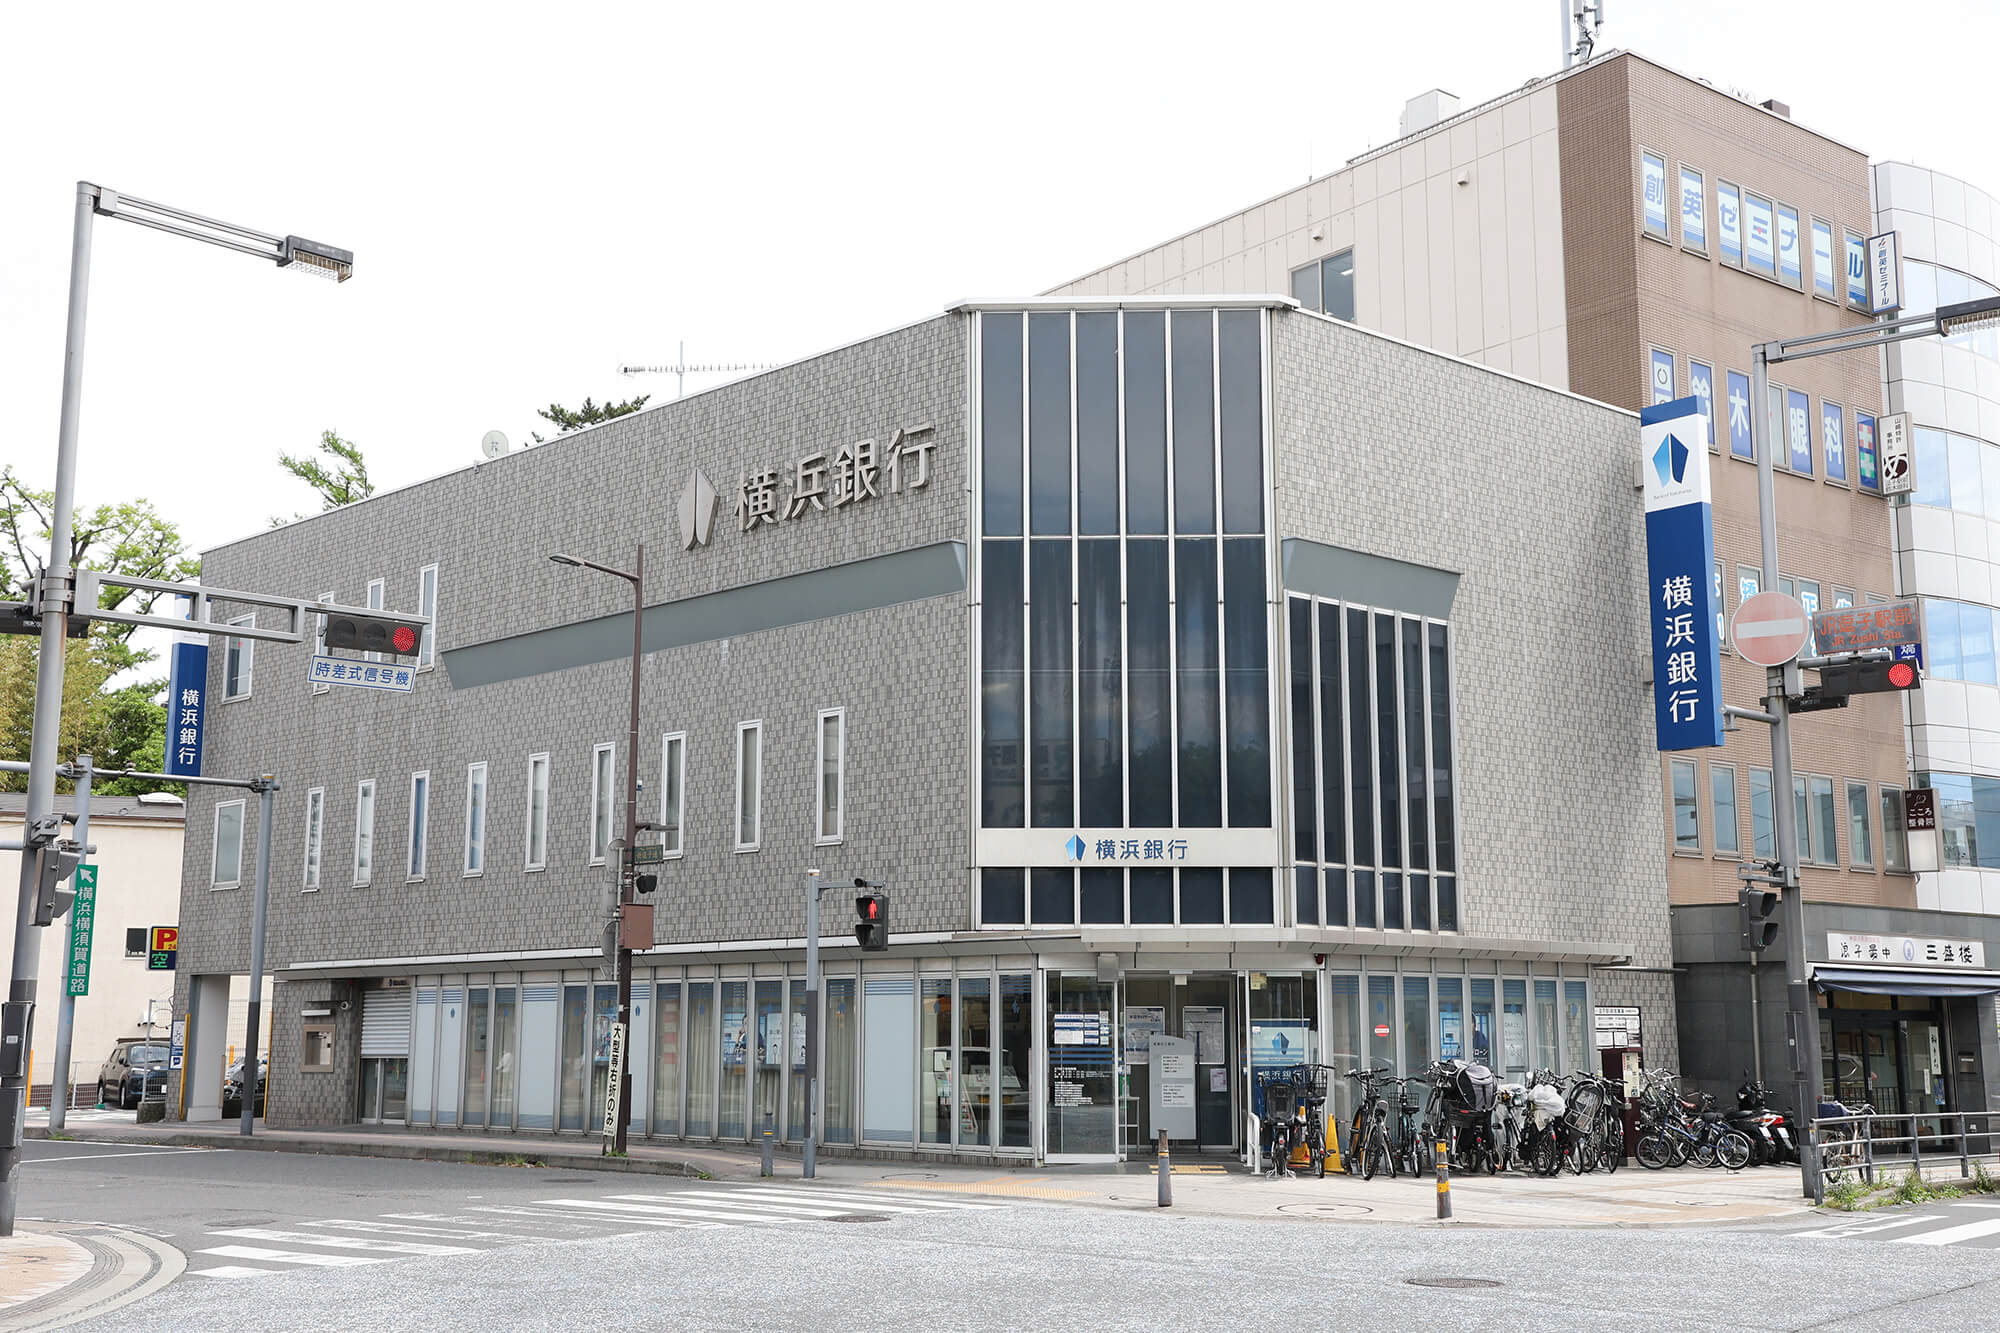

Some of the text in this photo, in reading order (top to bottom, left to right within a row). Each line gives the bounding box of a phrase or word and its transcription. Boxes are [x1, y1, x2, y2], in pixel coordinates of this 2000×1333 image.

[734, 422, 937, 532] 横浜銀行
[1820, 607, 1913, 636] JR逗子駅前
[1662, 574, 1699, 724] 横浜銀行
[1831, 630, 1905, 647] JR Zushi Sta.
[315, 661, 410, 686] 時差式信号機
[178, 688, 200, 765] 横浜銀行
[1095, 839, 1188, 860] 横浜銀行
[70, 886, 93, 993] 横浜横須賀道路
[156, 929, 178, 950] P
[151, 952, 168, 968] 空
